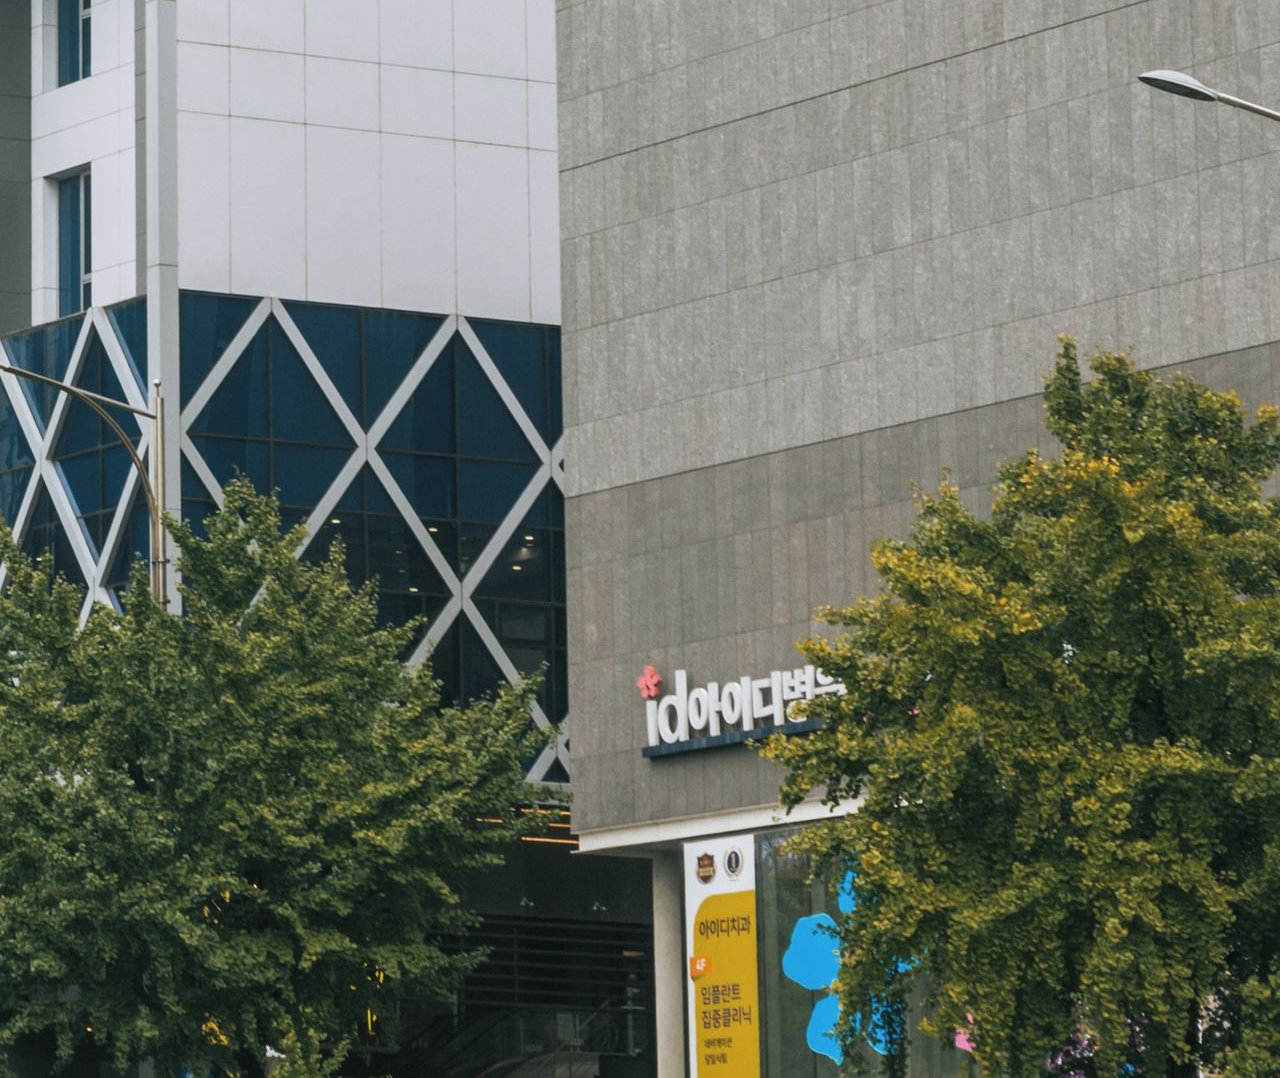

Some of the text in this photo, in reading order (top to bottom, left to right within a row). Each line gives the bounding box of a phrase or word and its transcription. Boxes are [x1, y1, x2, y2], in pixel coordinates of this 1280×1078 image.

[698, 914, 751, 939] 아이디치과
[695, 957, 707, 971] 4F
[701, 983, 742, 1005] 임플란트
[702, 1006, 752, 1029] 집중클리닉
